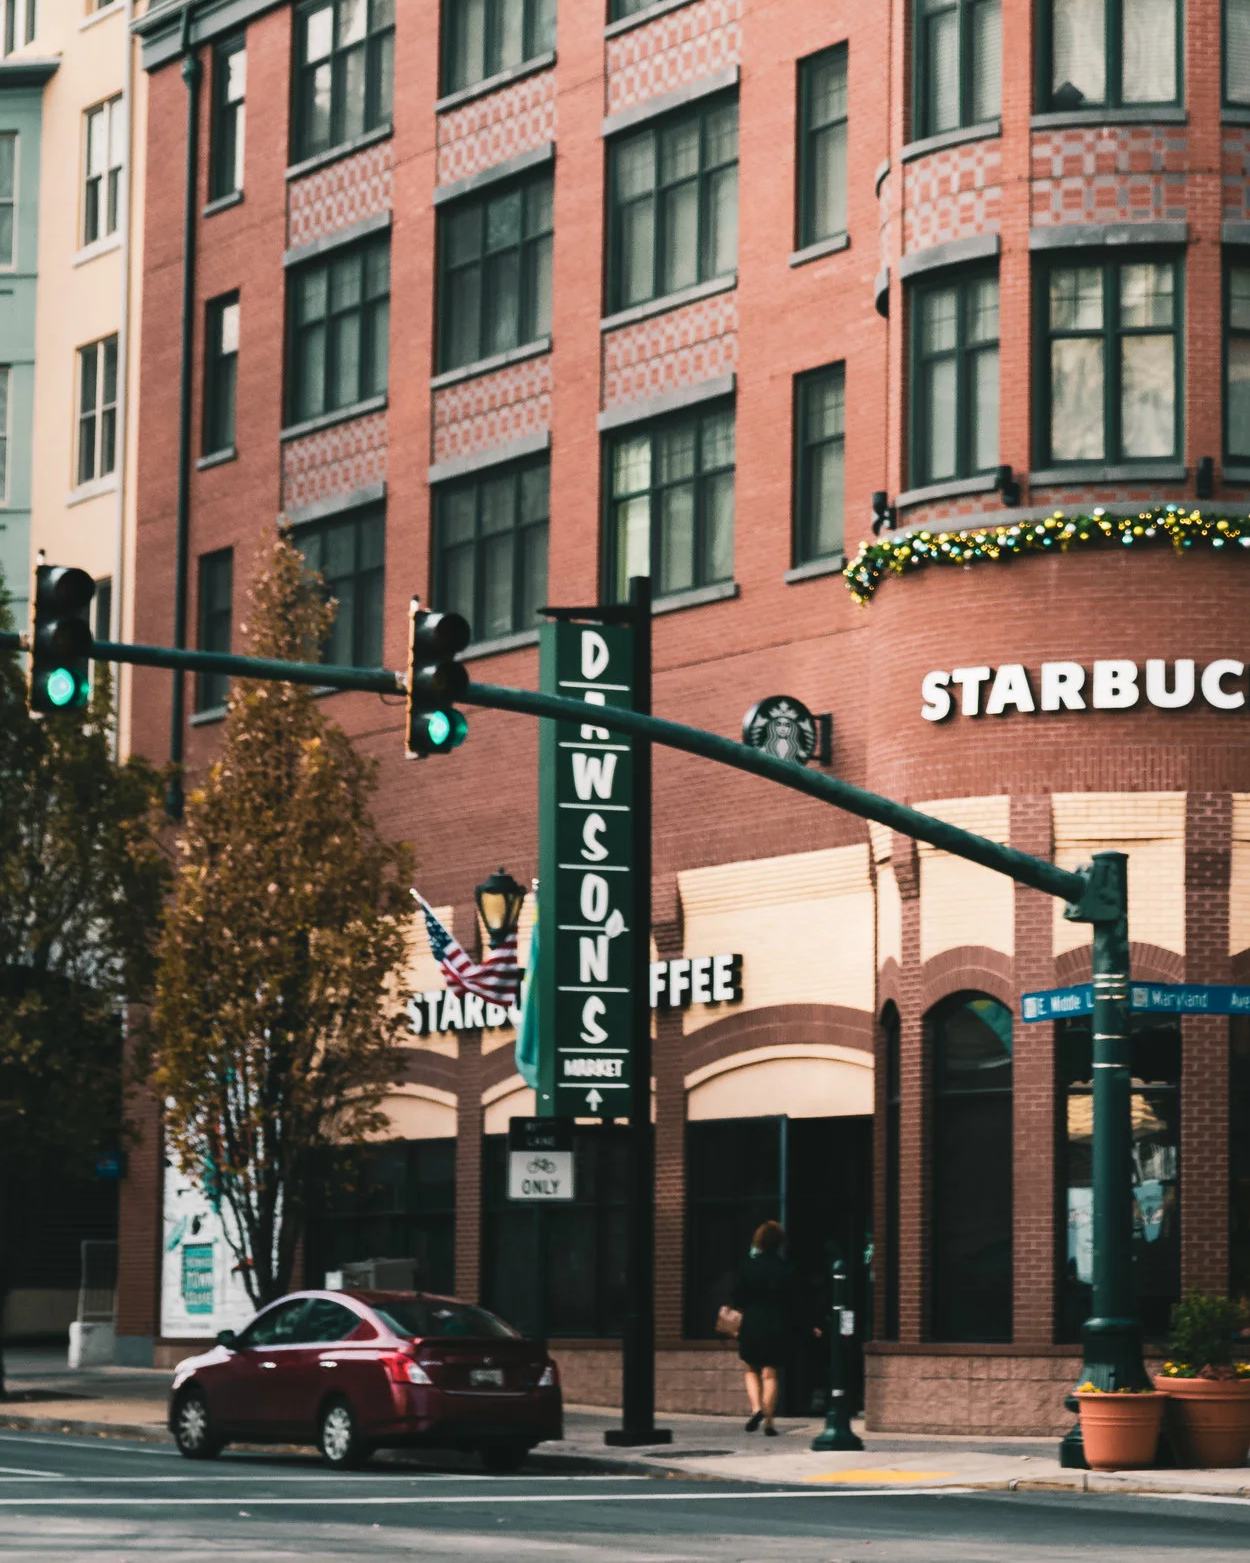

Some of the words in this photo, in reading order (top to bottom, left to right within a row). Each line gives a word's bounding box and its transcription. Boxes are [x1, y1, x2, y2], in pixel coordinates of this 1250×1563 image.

[649, 954, 734, 1008] FFEE
[1086, 990, 1095, 1009] L
[1151, 989, 1208, 1011] Maryland
[1230, 990, 1250, 1009] Ave
[563, 1058, 624, 1078] MARKET
[521, 1178, 561, 1196] ONLY
